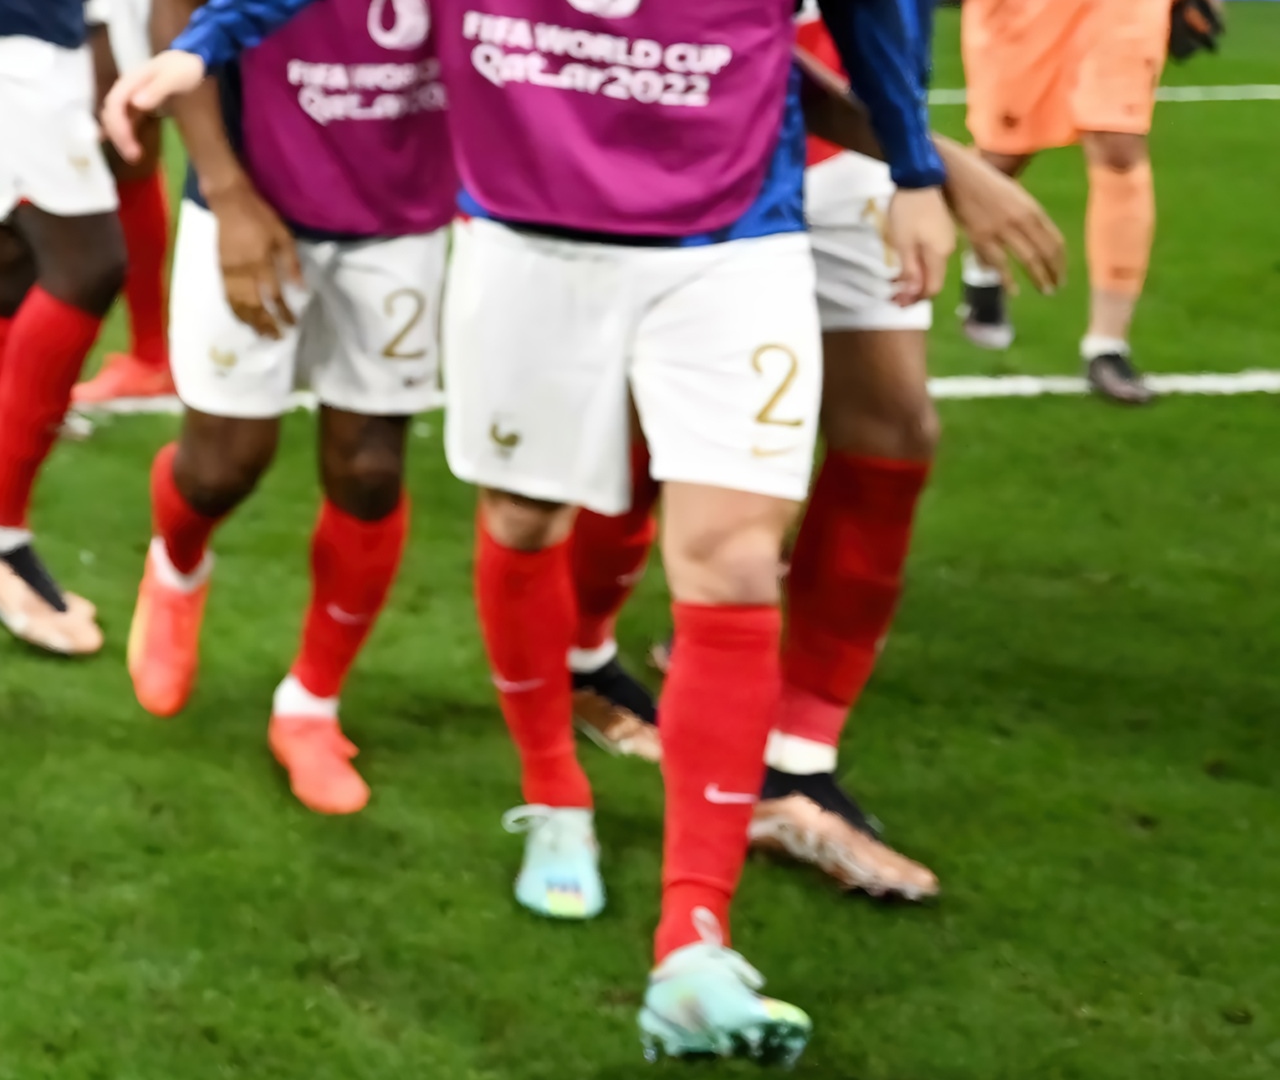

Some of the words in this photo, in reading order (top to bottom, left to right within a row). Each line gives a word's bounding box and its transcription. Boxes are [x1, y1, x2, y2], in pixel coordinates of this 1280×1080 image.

[462, 9, 533, 50] FIFA
[534, 22, 663, 70] WORLD
[663, 42, 733, 75] CUP
[751, 343, 805, 427] 2
